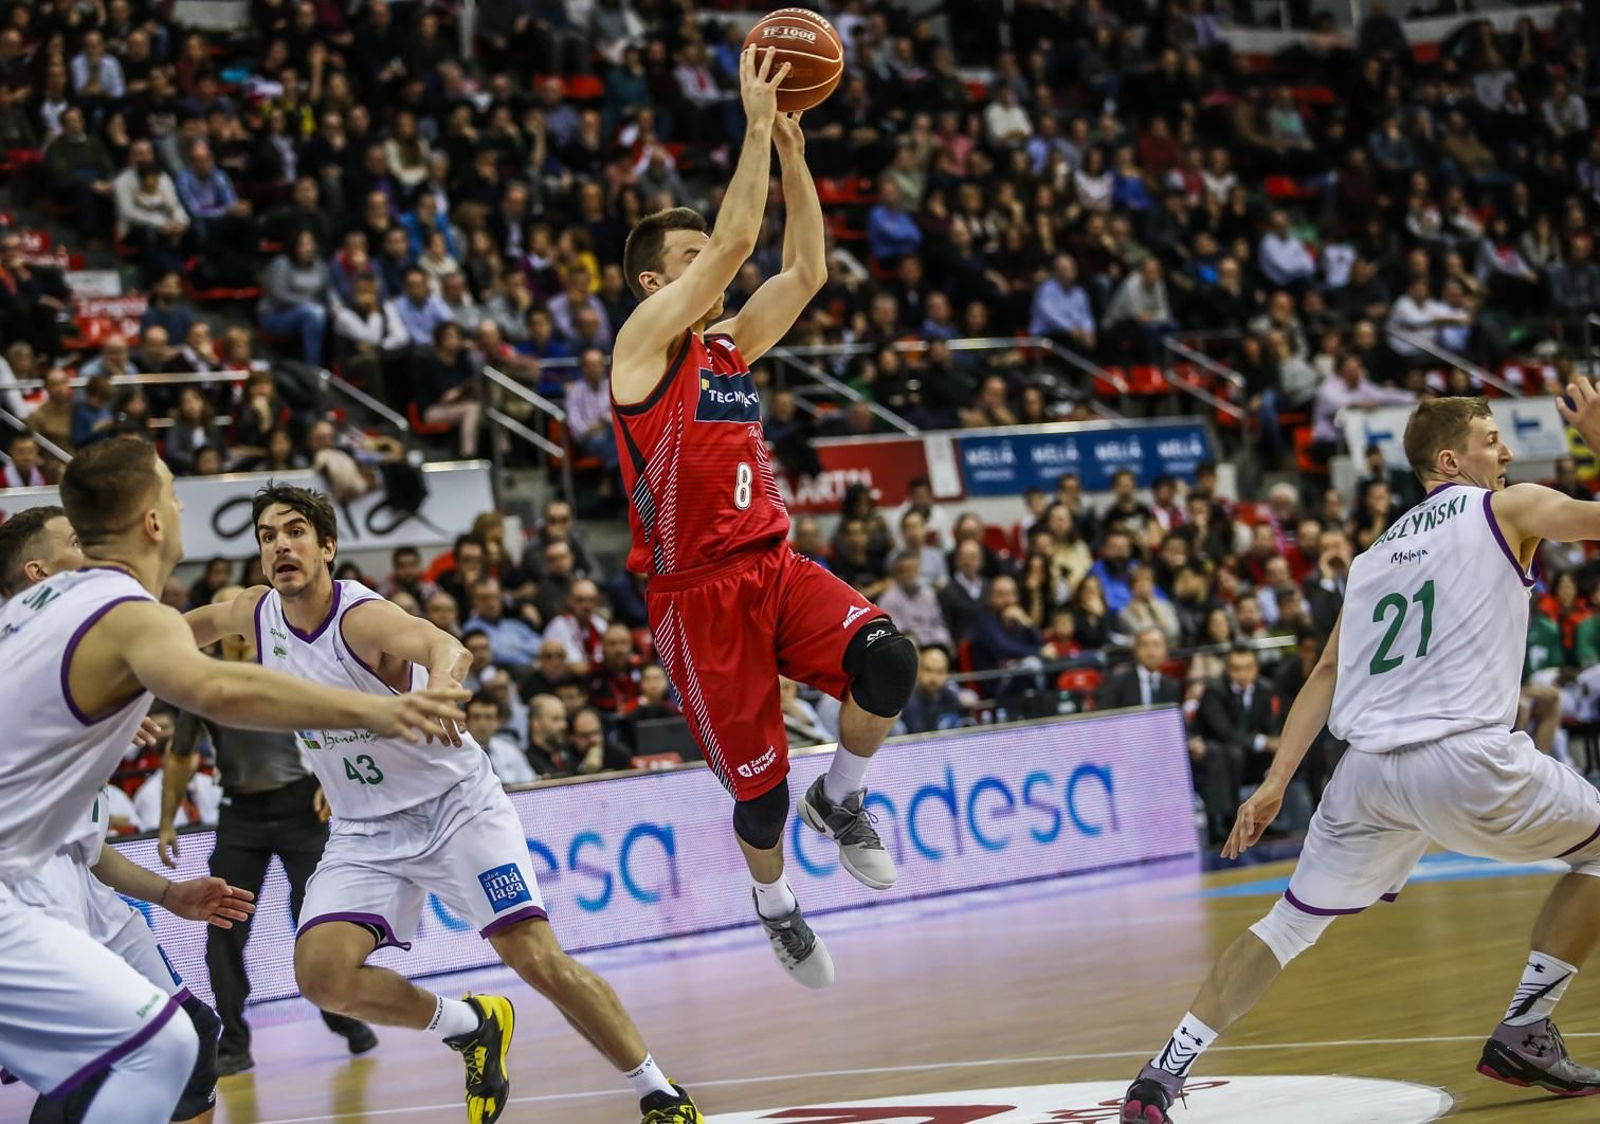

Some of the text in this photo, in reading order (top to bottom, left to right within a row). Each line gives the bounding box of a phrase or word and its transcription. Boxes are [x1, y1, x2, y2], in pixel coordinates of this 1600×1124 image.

[736, 462, 751, 509] 8
[1369, 579, 1435, 676] 21
[343, 754, 384, 785] 43
